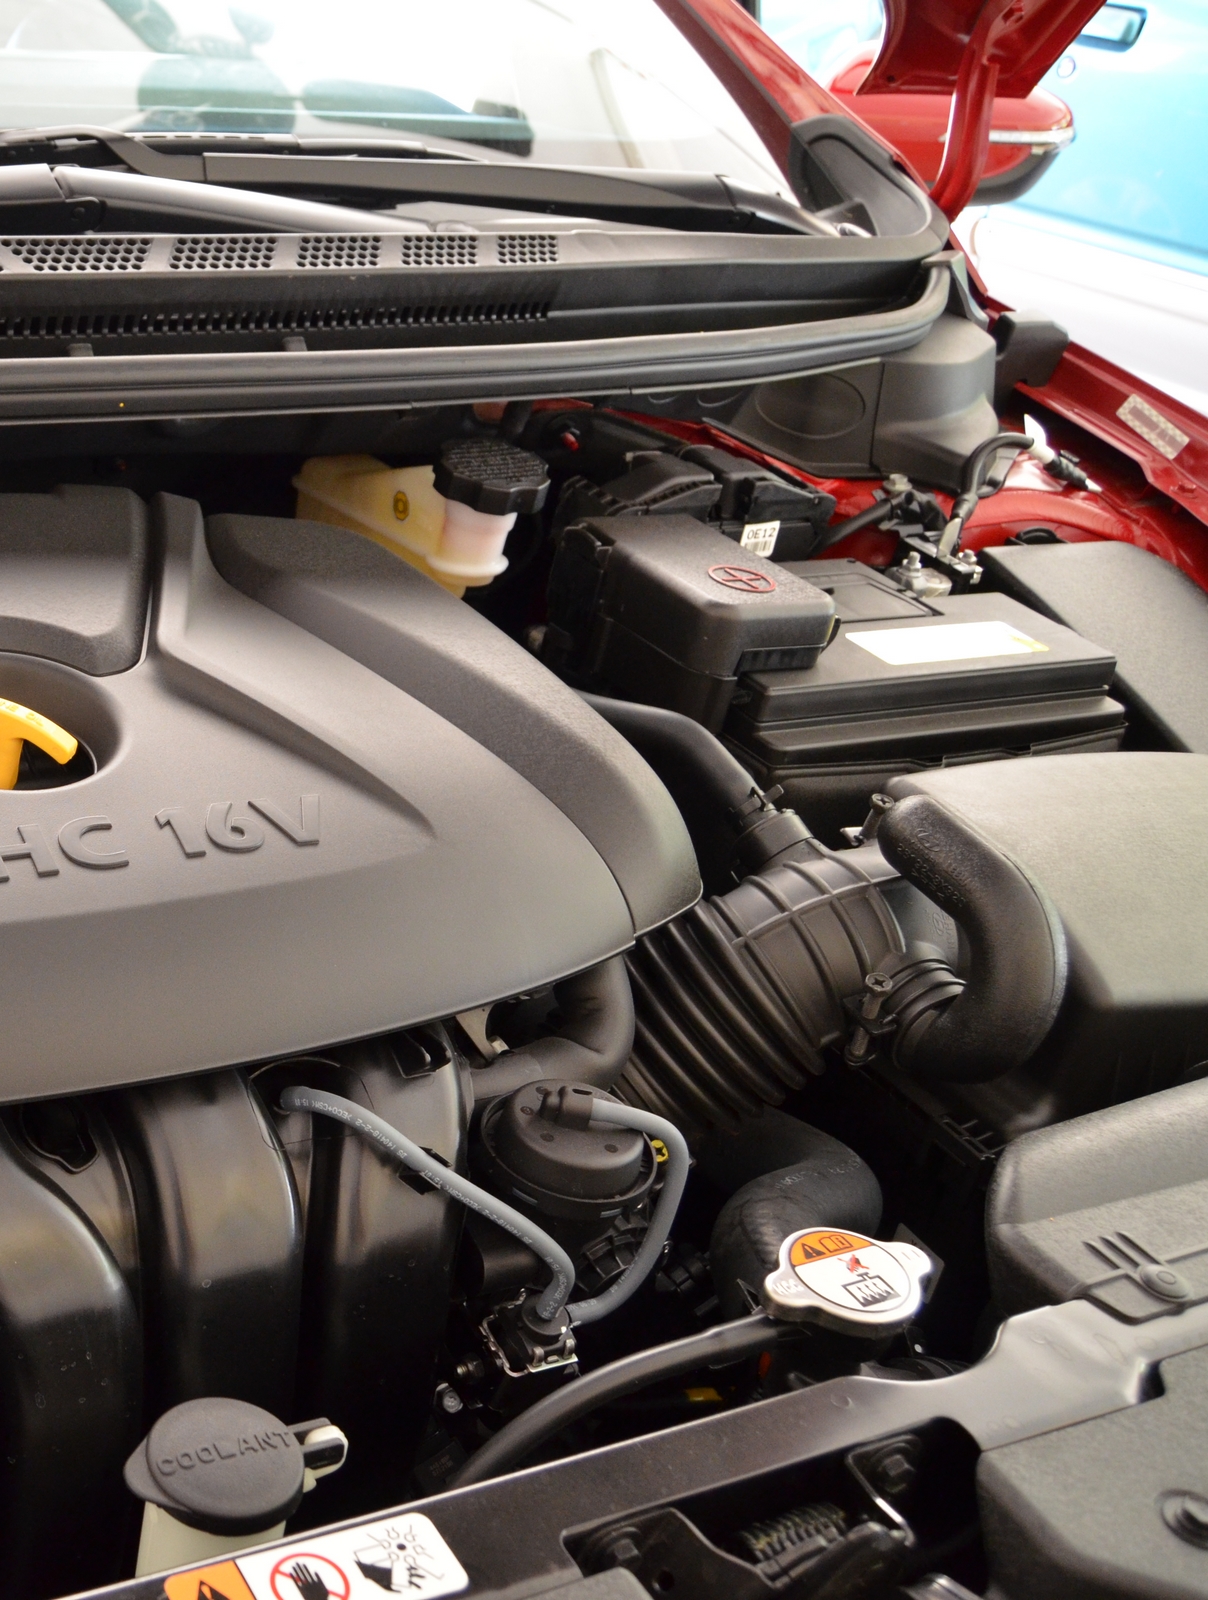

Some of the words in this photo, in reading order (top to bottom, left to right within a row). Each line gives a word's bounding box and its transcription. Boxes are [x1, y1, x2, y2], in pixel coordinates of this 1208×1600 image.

[25, 712, 44, 727] OIL
[153, 794, 320, 859] 16V
[155, 1431, 291, 1476] COOLANT
